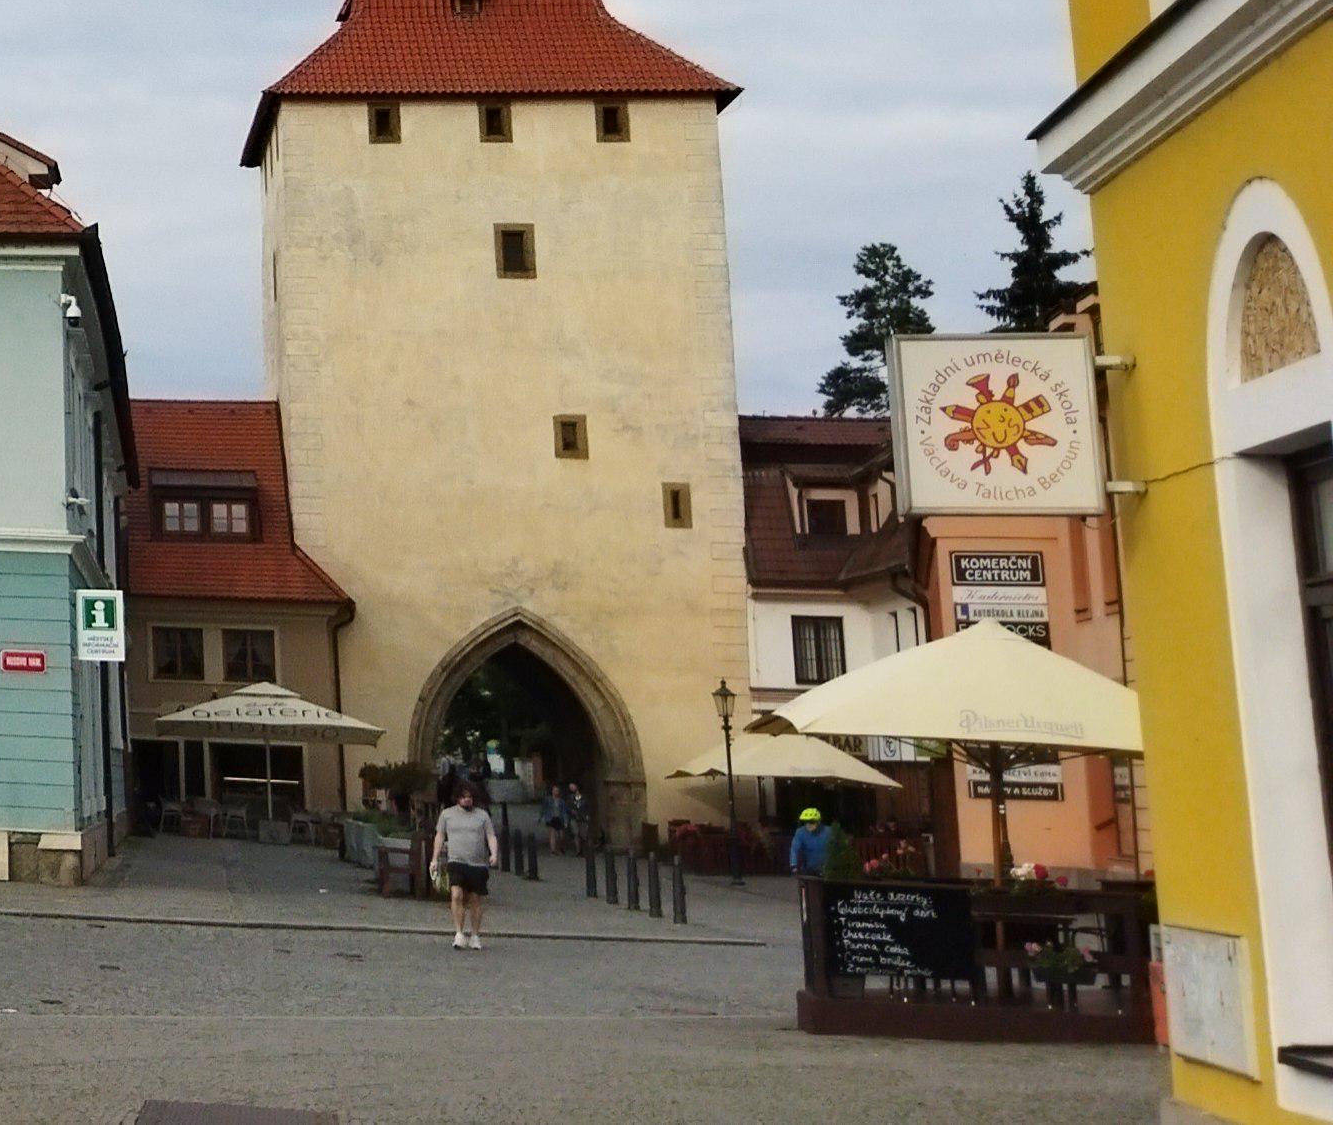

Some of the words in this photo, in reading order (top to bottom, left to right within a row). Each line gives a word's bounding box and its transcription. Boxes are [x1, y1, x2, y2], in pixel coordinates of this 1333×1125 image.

[915, 356, 962, 426] Základní
[963, 349, 1052, 383] umělecká
[1049, 379, 1078, 426] škola
[919, 435, 969, 491] Václava
[973, 481, 1037, 502] Talicha
[1037, 439, 1082, 492] Beroun
[960, 555, 1033, 570] KOMERČNÍ
[964, 569, 1032, 581] CENTRUM
